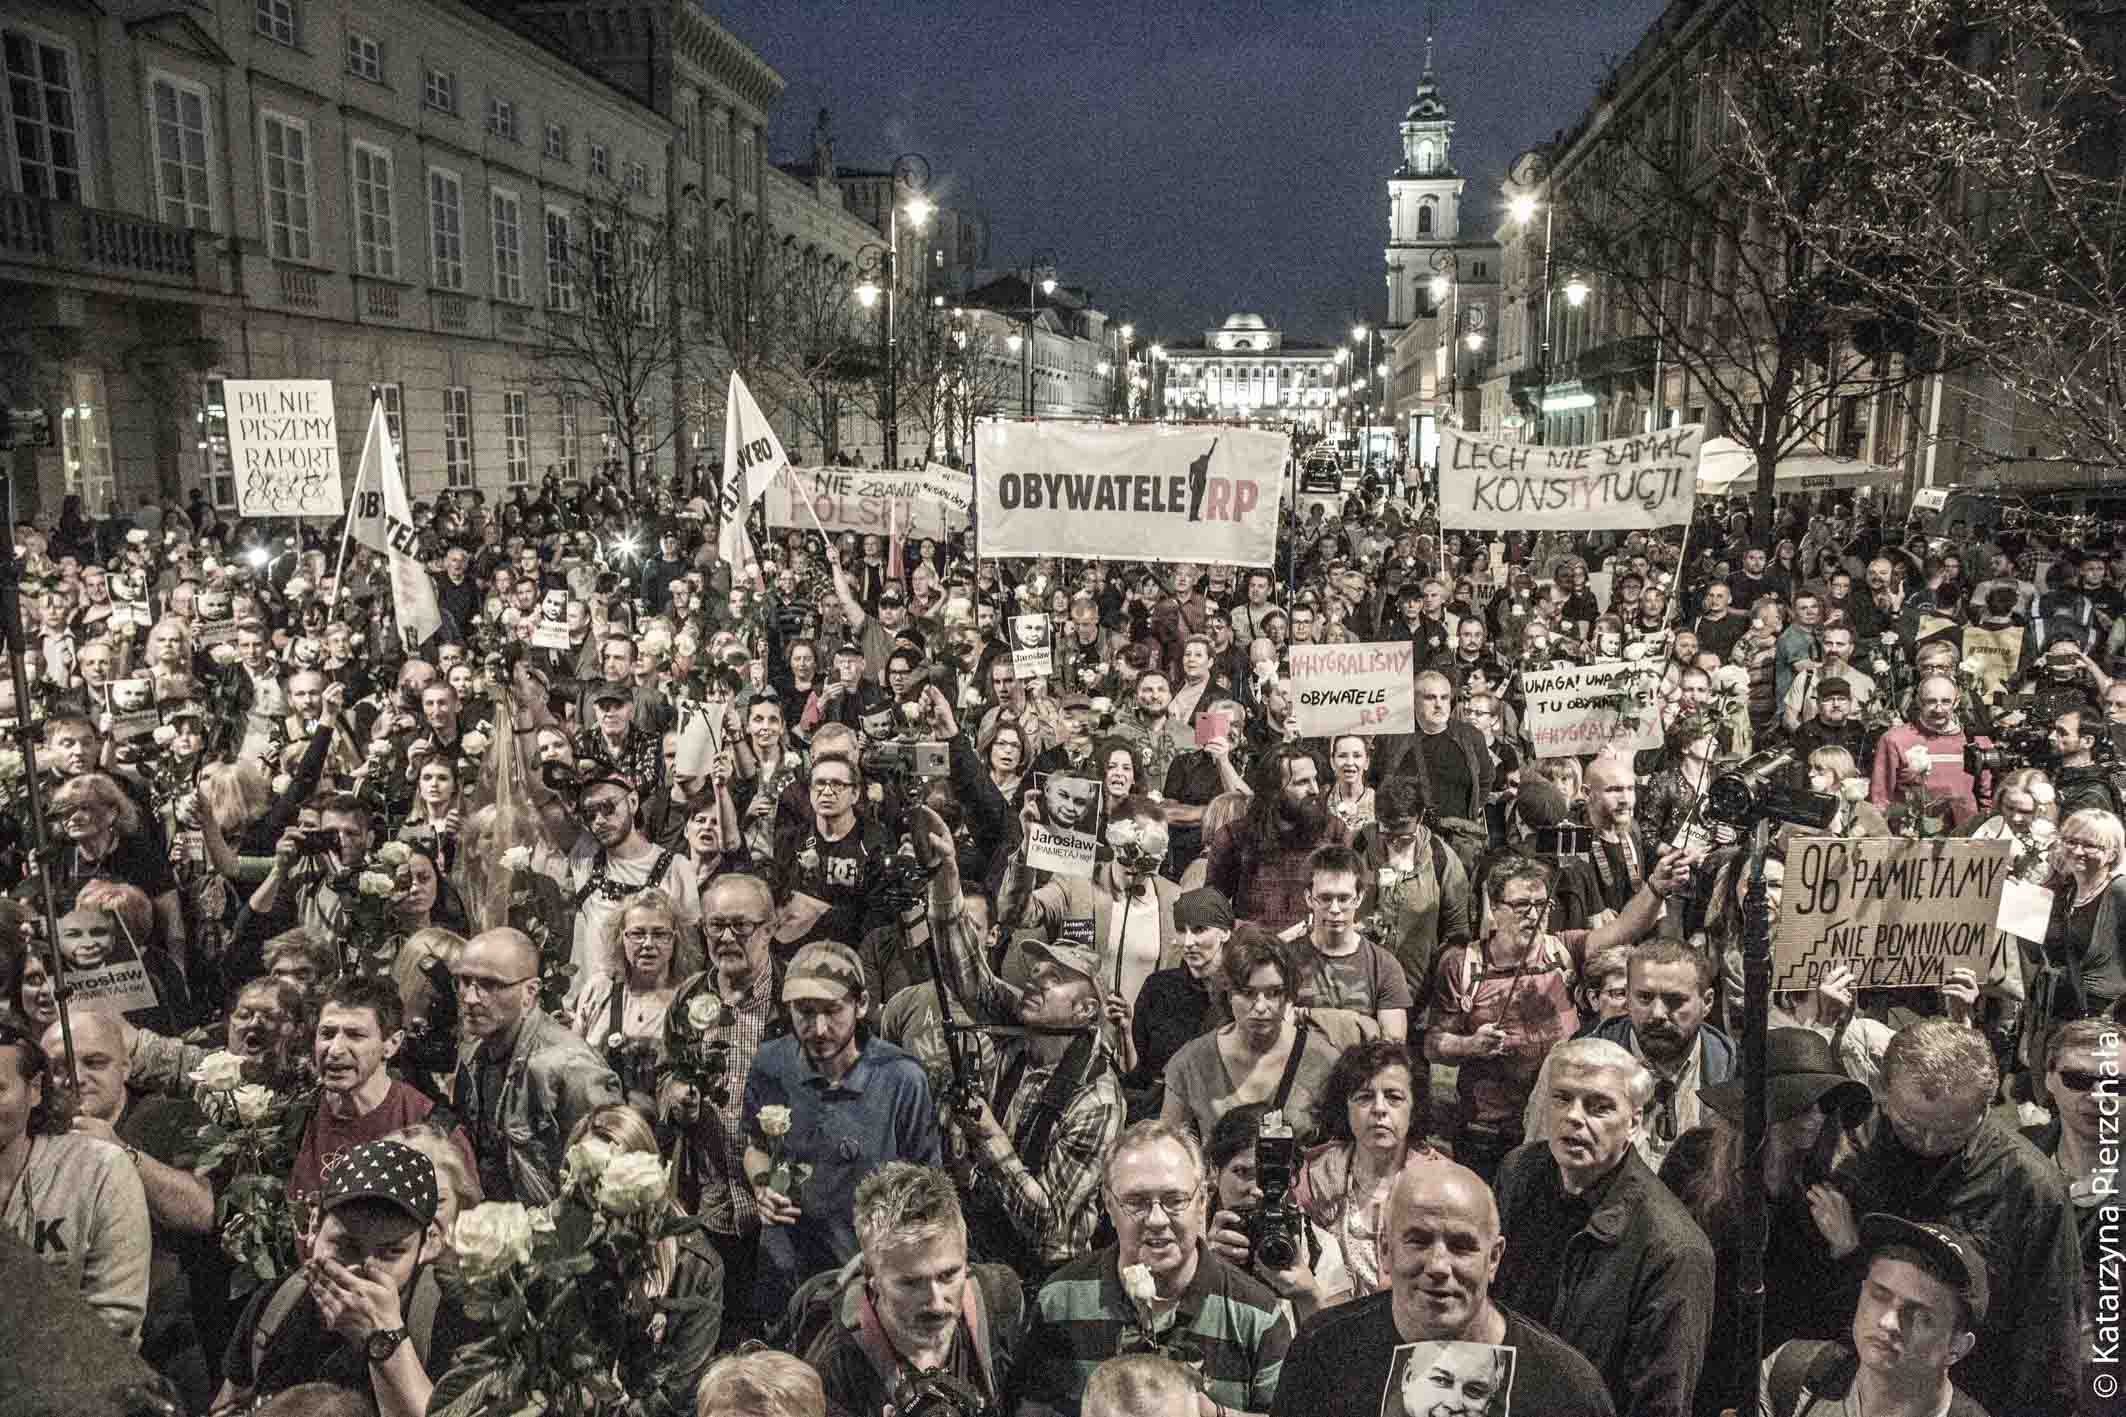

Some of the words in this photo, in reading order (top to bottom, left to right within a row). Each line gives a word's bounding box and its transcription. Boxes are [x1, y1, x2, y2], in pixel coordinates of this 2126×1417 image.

[239, 416, 333, 441] PISZEMY
[245, 446, 336, 468] RAPORT
[1452, 436, 1531, 471] LECH
[1547, 449, 1593, 469] NIE
[815, 473, 853, 497] NIE
[999, 472, 1187, 512] OBYWATELE
[1206, 478, 1261, 522] RP
[1472, 467, 1683, 512] KONSTYTUCJI
[1525, 674, 1581, 696] UWAGA!
[1300, 688, 1385, 707] OBYWATELE
[1537, 701, 1562, 714] TU
[1031, 829, 1095, 851] Jarosław
[1796, 843, 1847, 914] 96
[1850, 856, 2005, 904] PAMIĘTAMY
[1831, 926, 1869, 957] NIE
[1875, 921, 1986, 956] POMNIKOM
